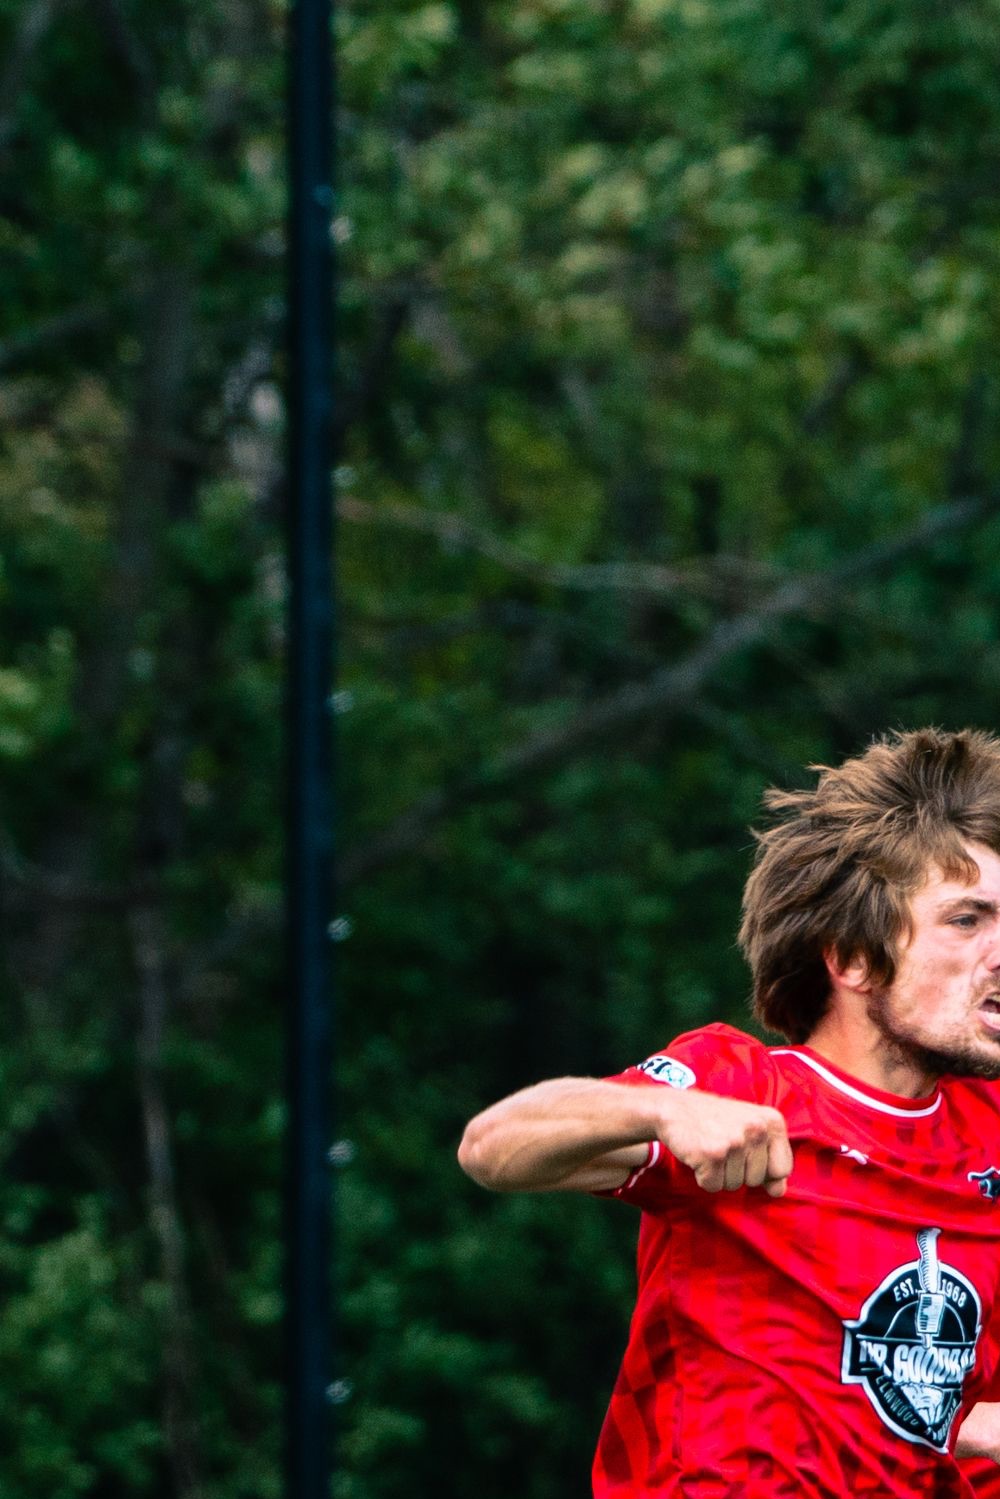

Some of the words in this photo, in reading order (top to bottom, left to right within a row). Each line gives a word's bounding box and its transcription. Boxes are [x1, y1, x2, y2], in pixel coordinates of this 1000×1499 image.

[893, 1278, 918, 1302] EST.
[942, 1279, 967, 1308] 1968
[893, 1344, 976, 1385] GOODB
